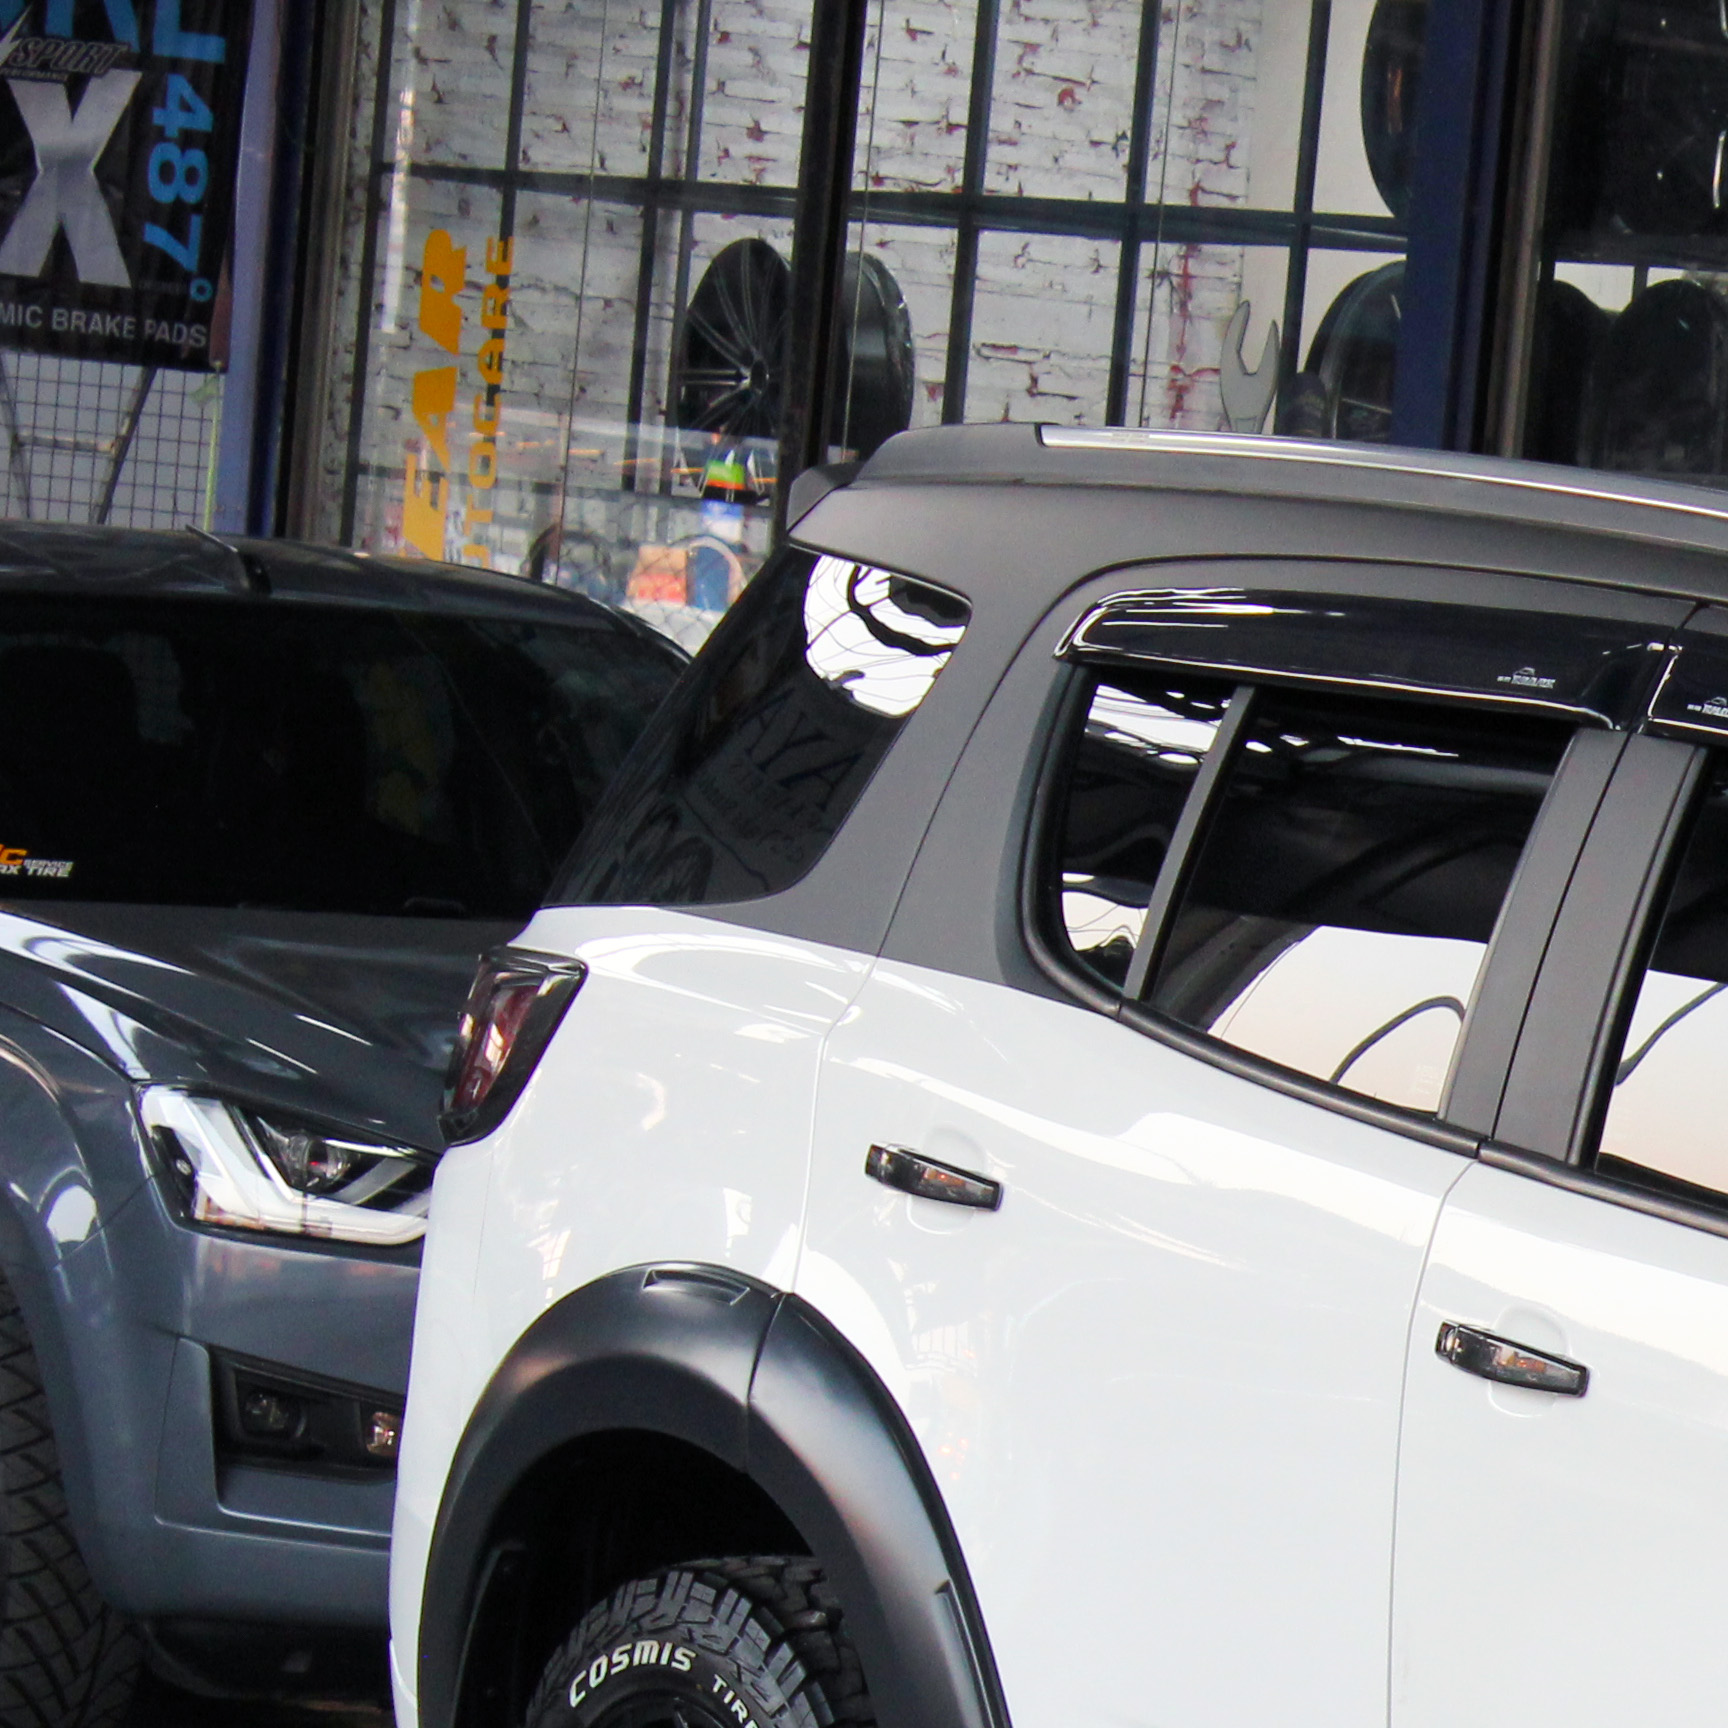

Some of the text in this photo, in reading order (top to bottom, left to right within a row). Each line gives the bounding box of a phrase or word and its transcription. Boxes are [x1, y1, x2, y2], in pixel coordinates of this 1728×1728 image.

[9, 37, 131, 76] SPORT
[53, 309, 137, 340] BRAKE
[144, 318, 208, 348] PADS
[400, 229, 467, 562] EAR
[569, 1639, 697, 1708] COSMIS
